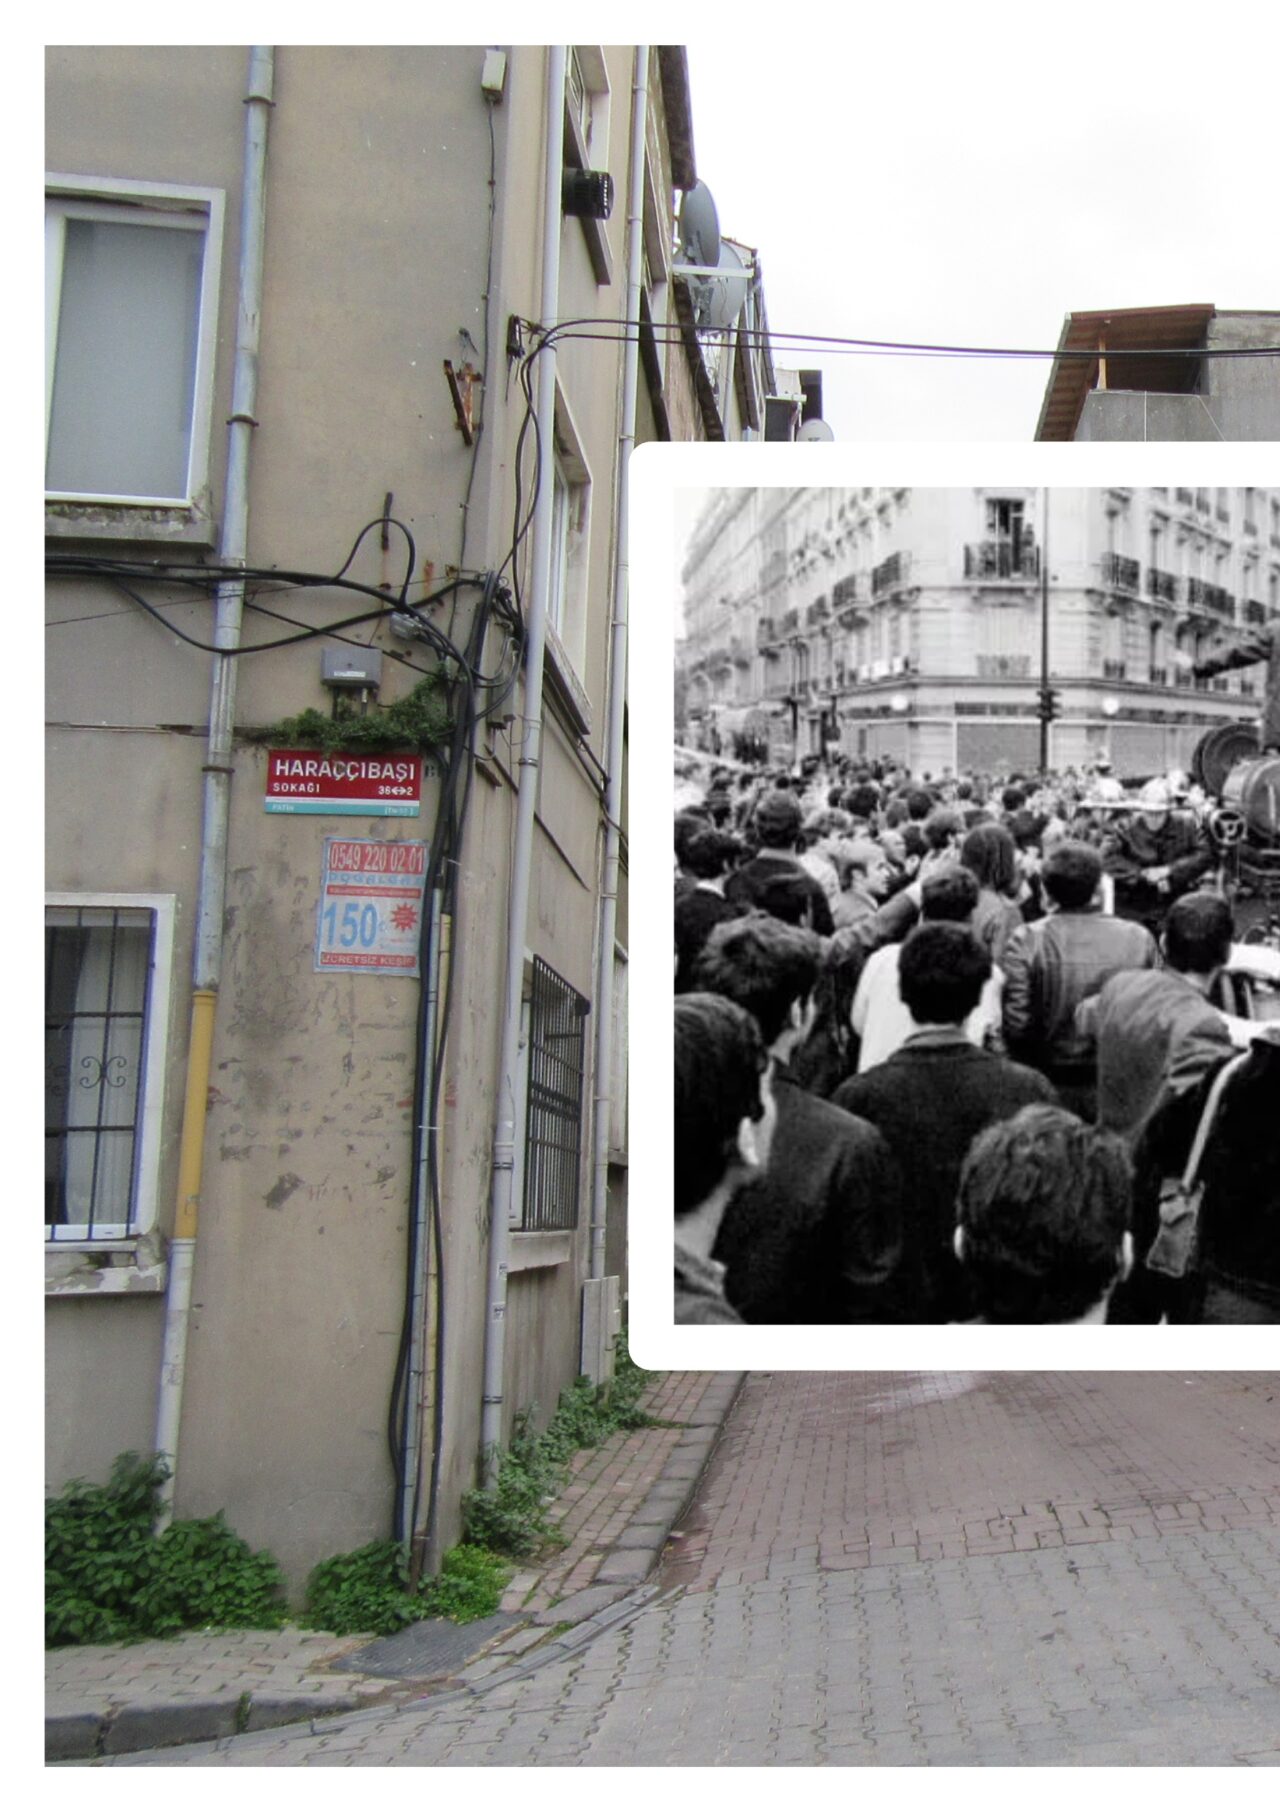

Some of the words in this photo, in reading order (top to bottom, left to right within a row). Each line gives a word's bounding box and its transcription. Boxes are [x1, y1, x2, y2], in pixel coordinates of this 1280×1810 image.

[275, 759, 415, 782] HARAÇÇIBAŞI
[273, 783, 320, 793] SOKAĞI
[364, 846, 388, 871] 220
[390, 847, 406, 871] 02
[408, 848, 424, 872] 01
[325, 902, 378, 948] 150
